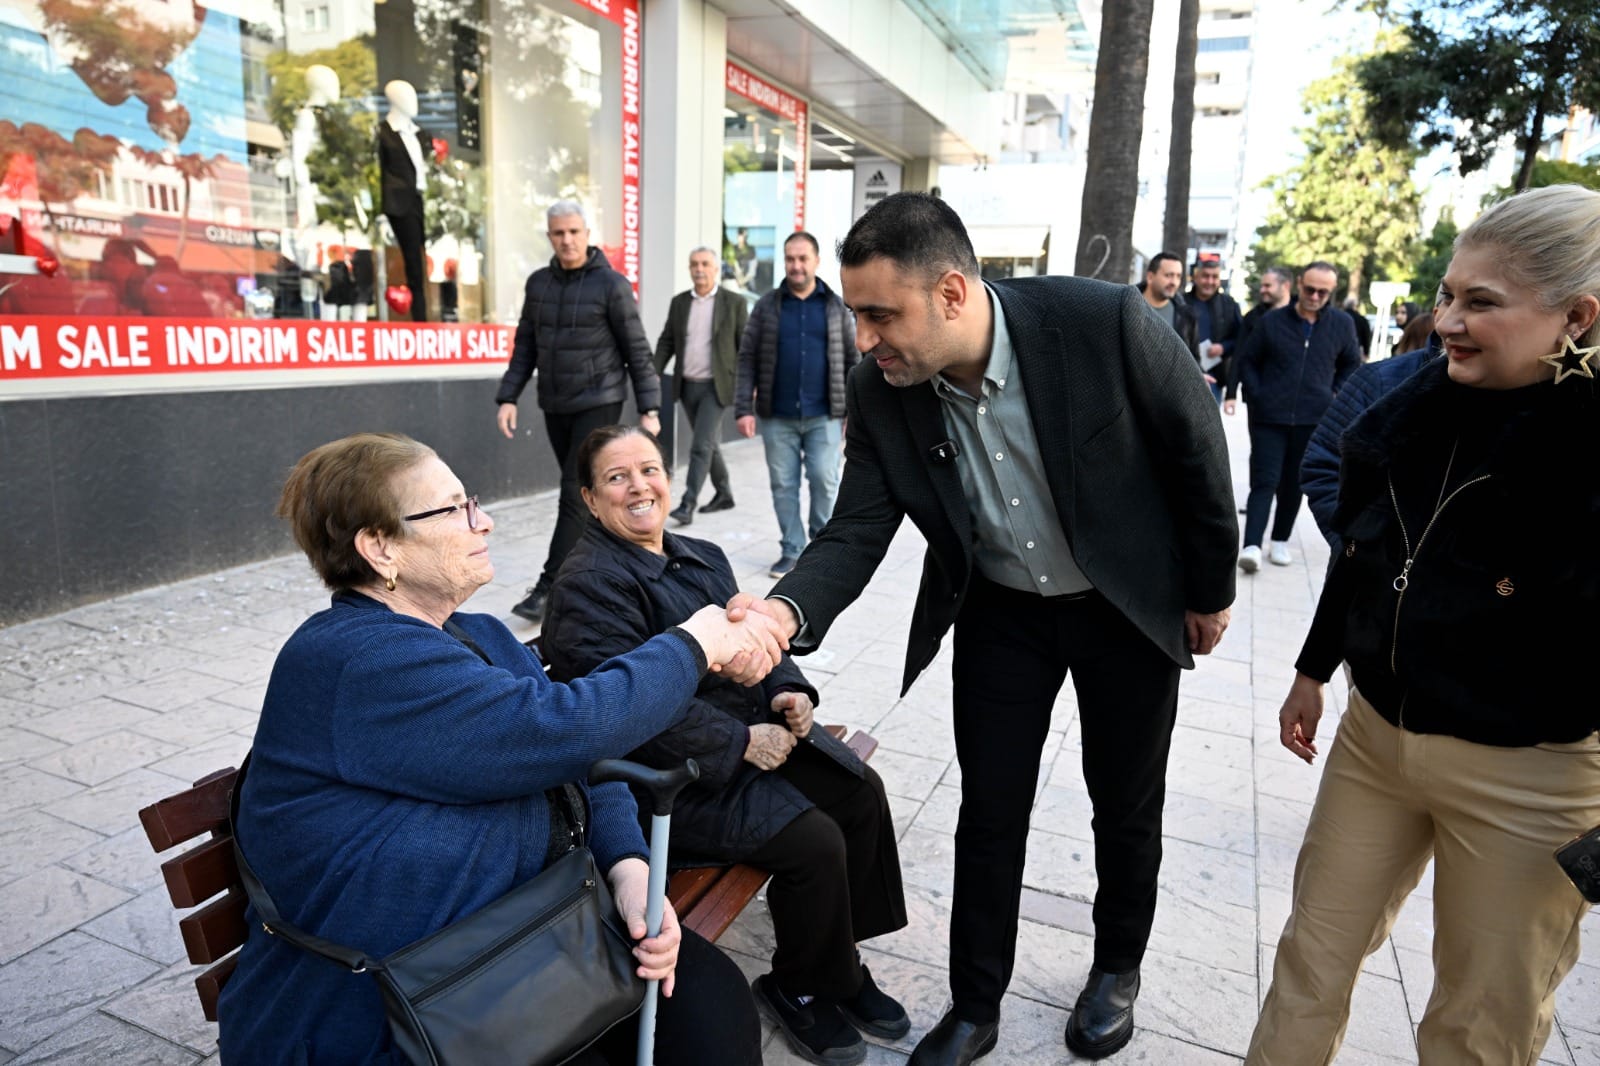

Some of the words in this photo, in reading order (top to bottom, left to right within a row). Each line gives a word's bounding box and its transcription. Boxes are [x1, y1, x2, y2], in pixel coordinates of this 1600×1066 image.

[727, 65, 748, 95] SALE
[779, 94, 796, 118] SALE
[623, 121, 638, 176] SALE
[57, 325, 151, 369] SALE
[307, 327, 367, 362] SALE
[467, 330, 508, 358] SALE
